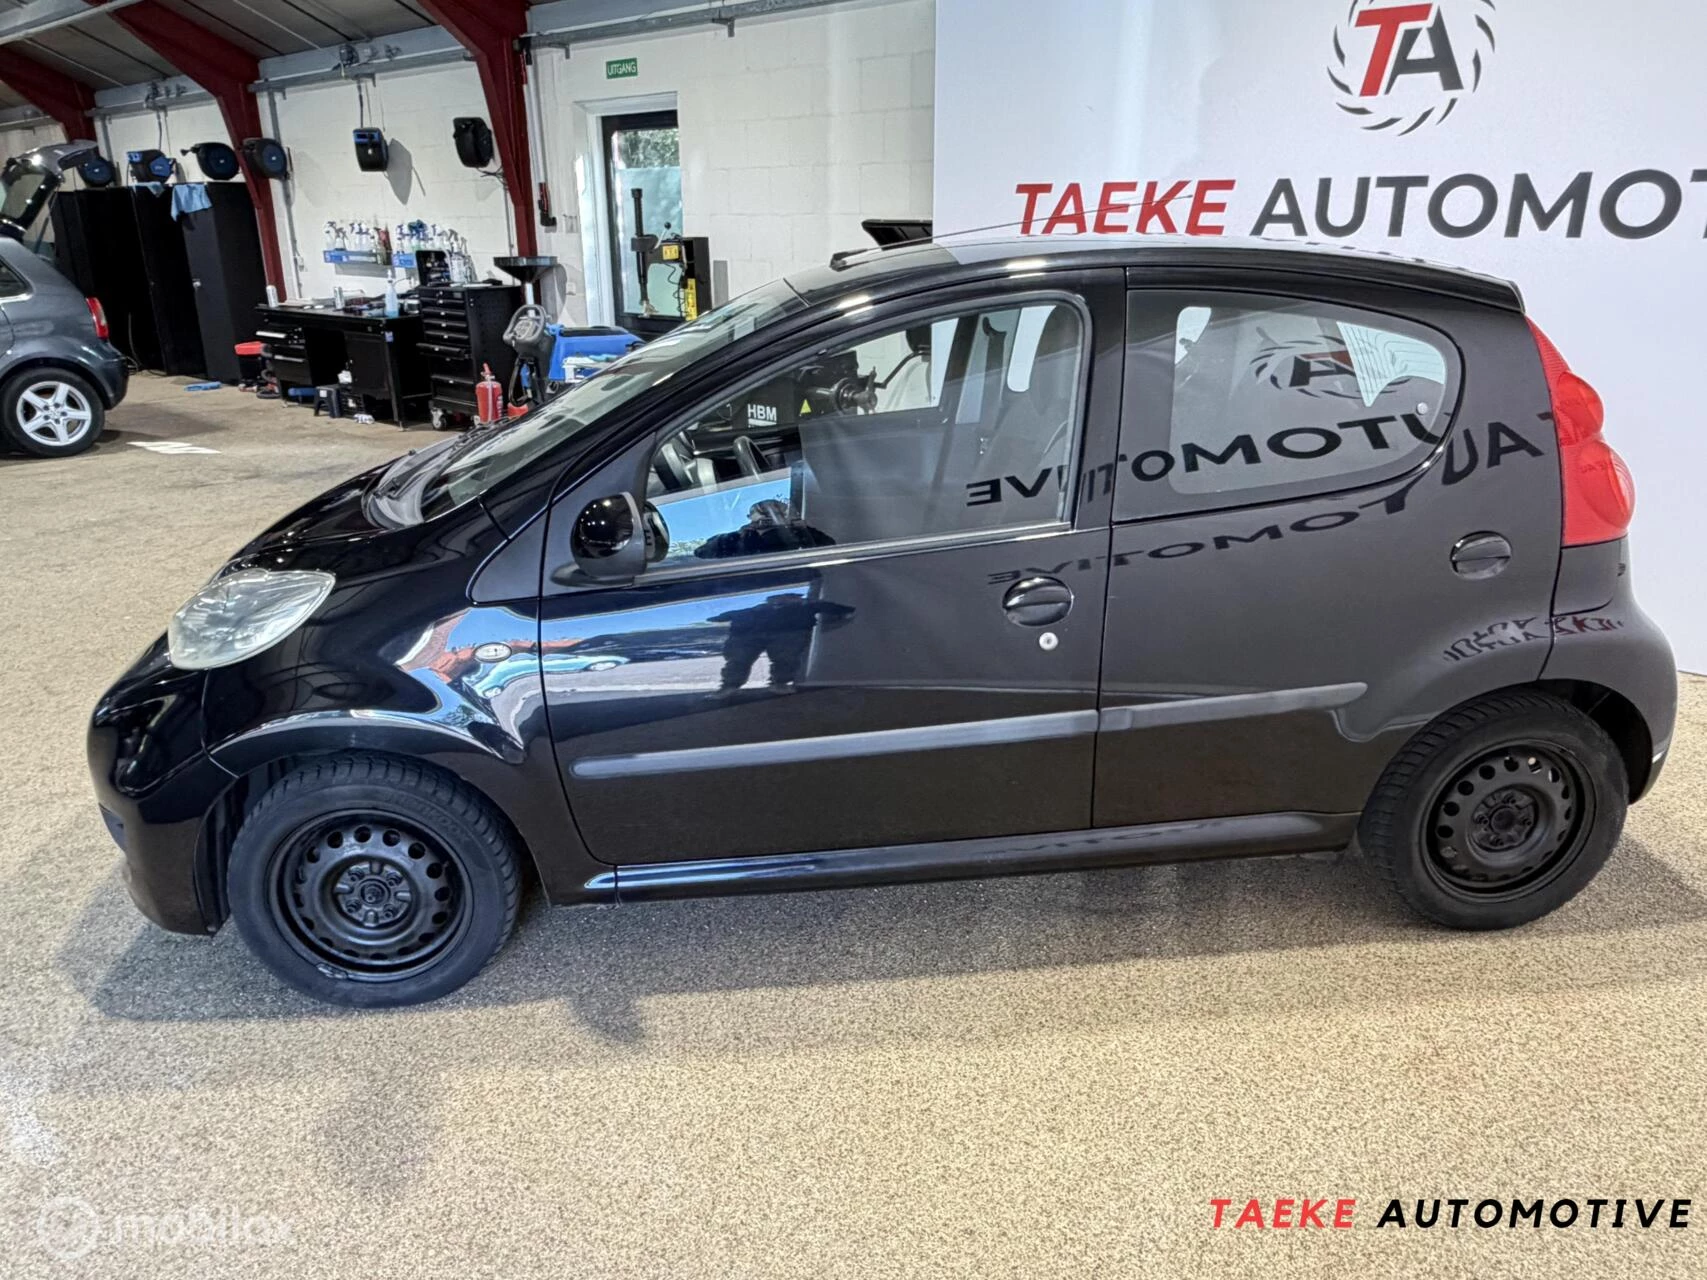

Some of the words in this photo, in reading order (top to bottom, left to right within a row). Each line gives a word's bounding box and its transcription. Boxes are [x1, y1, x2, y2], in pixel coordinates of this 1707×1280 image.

[607, 61, 637, 76] UITGANG
[1355, 3, 1464, 97] TA
[1014, 179, 1237, 236] TAEKE
[747, 403, 777, 421] HBM
